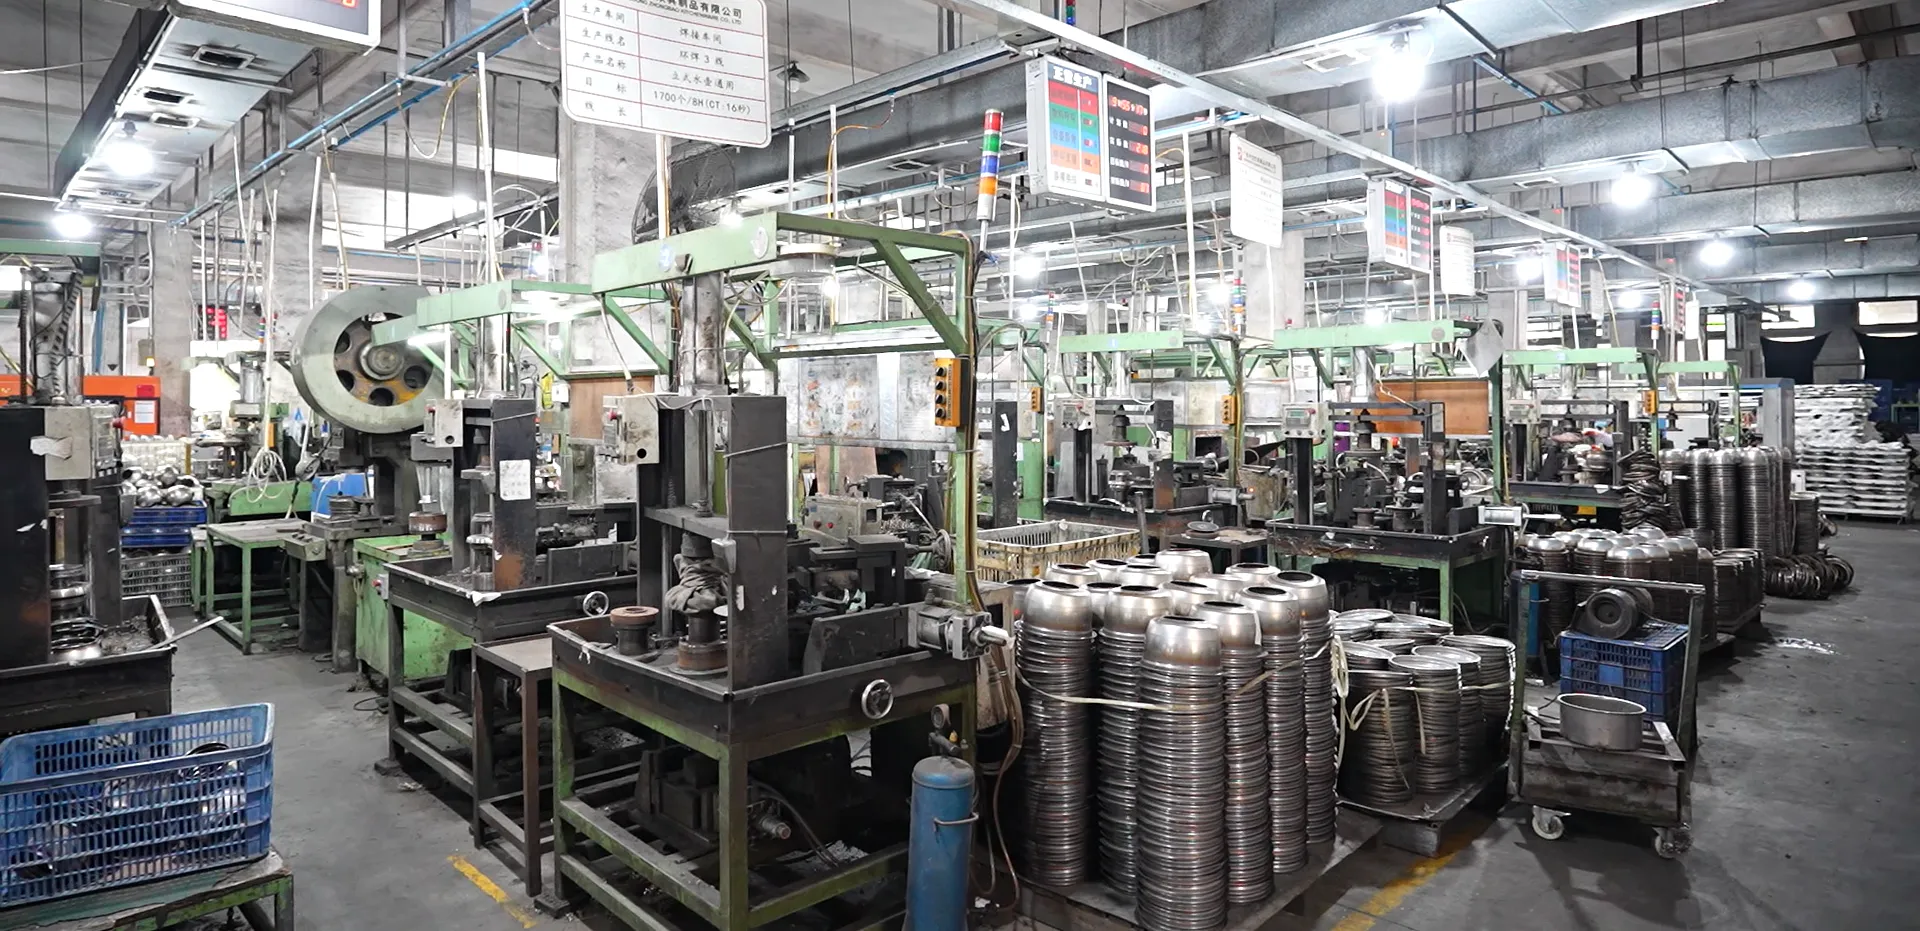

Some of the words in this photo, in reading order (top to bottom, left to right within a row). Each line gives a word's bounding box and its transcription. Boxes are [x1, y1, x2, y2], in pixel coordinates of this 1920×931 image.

[581, 4, 626, 24] 生产车间
[581, 27, 626, 47] 生产线名
[679, 26, 722, 45] 焊接车间
[582, 52, 627, 70] 产品名称
[672, 71, 735, 91] 立式水壶通用
